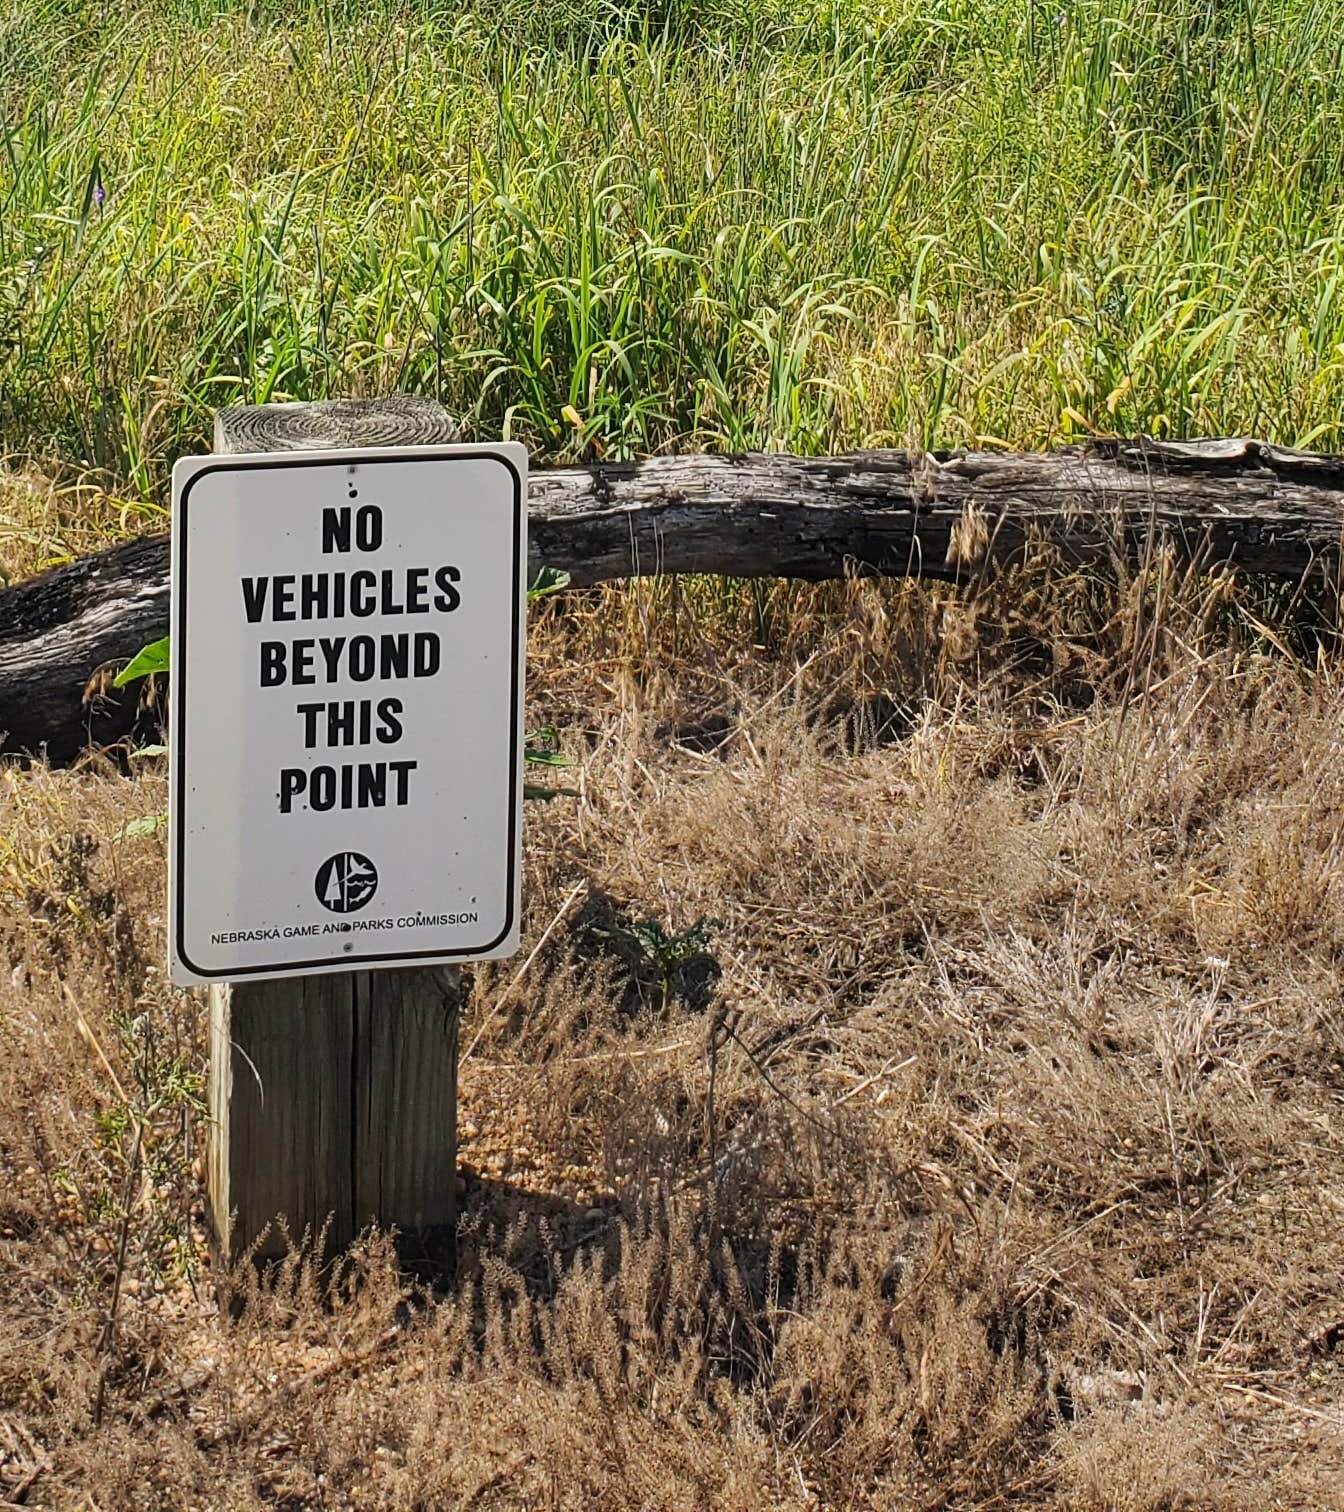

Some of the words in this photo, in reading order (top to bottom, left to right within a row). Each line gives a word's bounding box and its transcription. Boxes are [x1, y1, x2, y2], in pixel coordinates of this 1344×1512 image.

[322, 505, 383, 553] NO
[241, 566, 460, 623] VEHICLES
[260, 632, 440, 687] BEYOND
[297, 698, 402, 748] THIS
[279, 761, 417, 813] POINT
[211, 928, 280, 945] NEBRASKA
[284, 924, 319, 938] GAME
[353, 919, 393, 932] PARKS
[397, 912, 478, 928] COMMISSION
